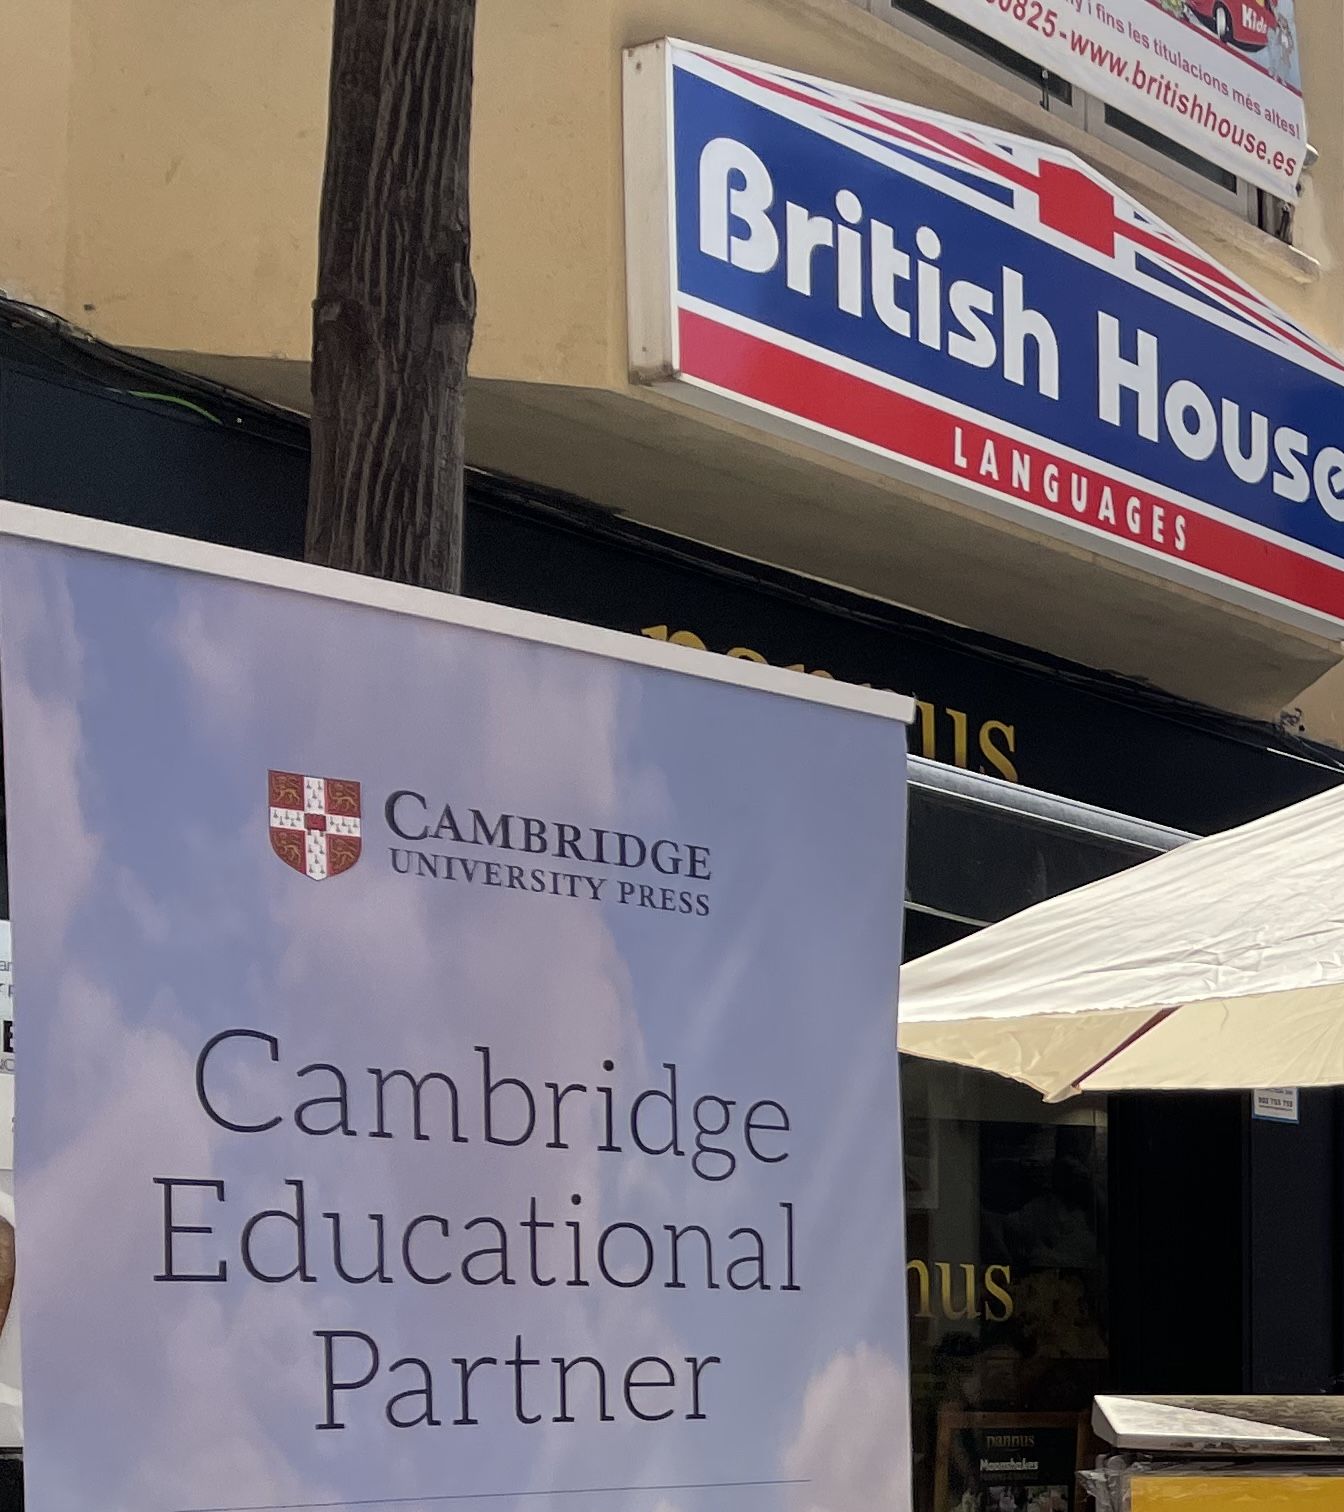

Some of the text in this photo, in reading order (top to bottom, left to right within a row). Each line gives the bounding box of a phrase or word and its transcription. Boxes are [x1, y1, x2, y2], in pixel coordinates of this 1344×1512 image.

[1095, 3, 1125, 34] fins
[1128, 21, 1150, 49] les
[1153, 38, 1229, 96] titulacions
[1231, 91, 1261, 112] més
[1264, 107, 1301, 139] altes!
[1241, 3, 1268, 34] Kids
[700, 138, 1059, 400] British
[954, 427, 1188, 551] LANGUAGES
[385, 791, 713, 882] CAMBRIDGE
[390, 847, 711, 918] UNIVERSITY PRESS
[197, 1029, 791, 1183] Cambridge
[154, 1179, 802, 1292] Educational
[313, 1331, 720, 1431] Partner
